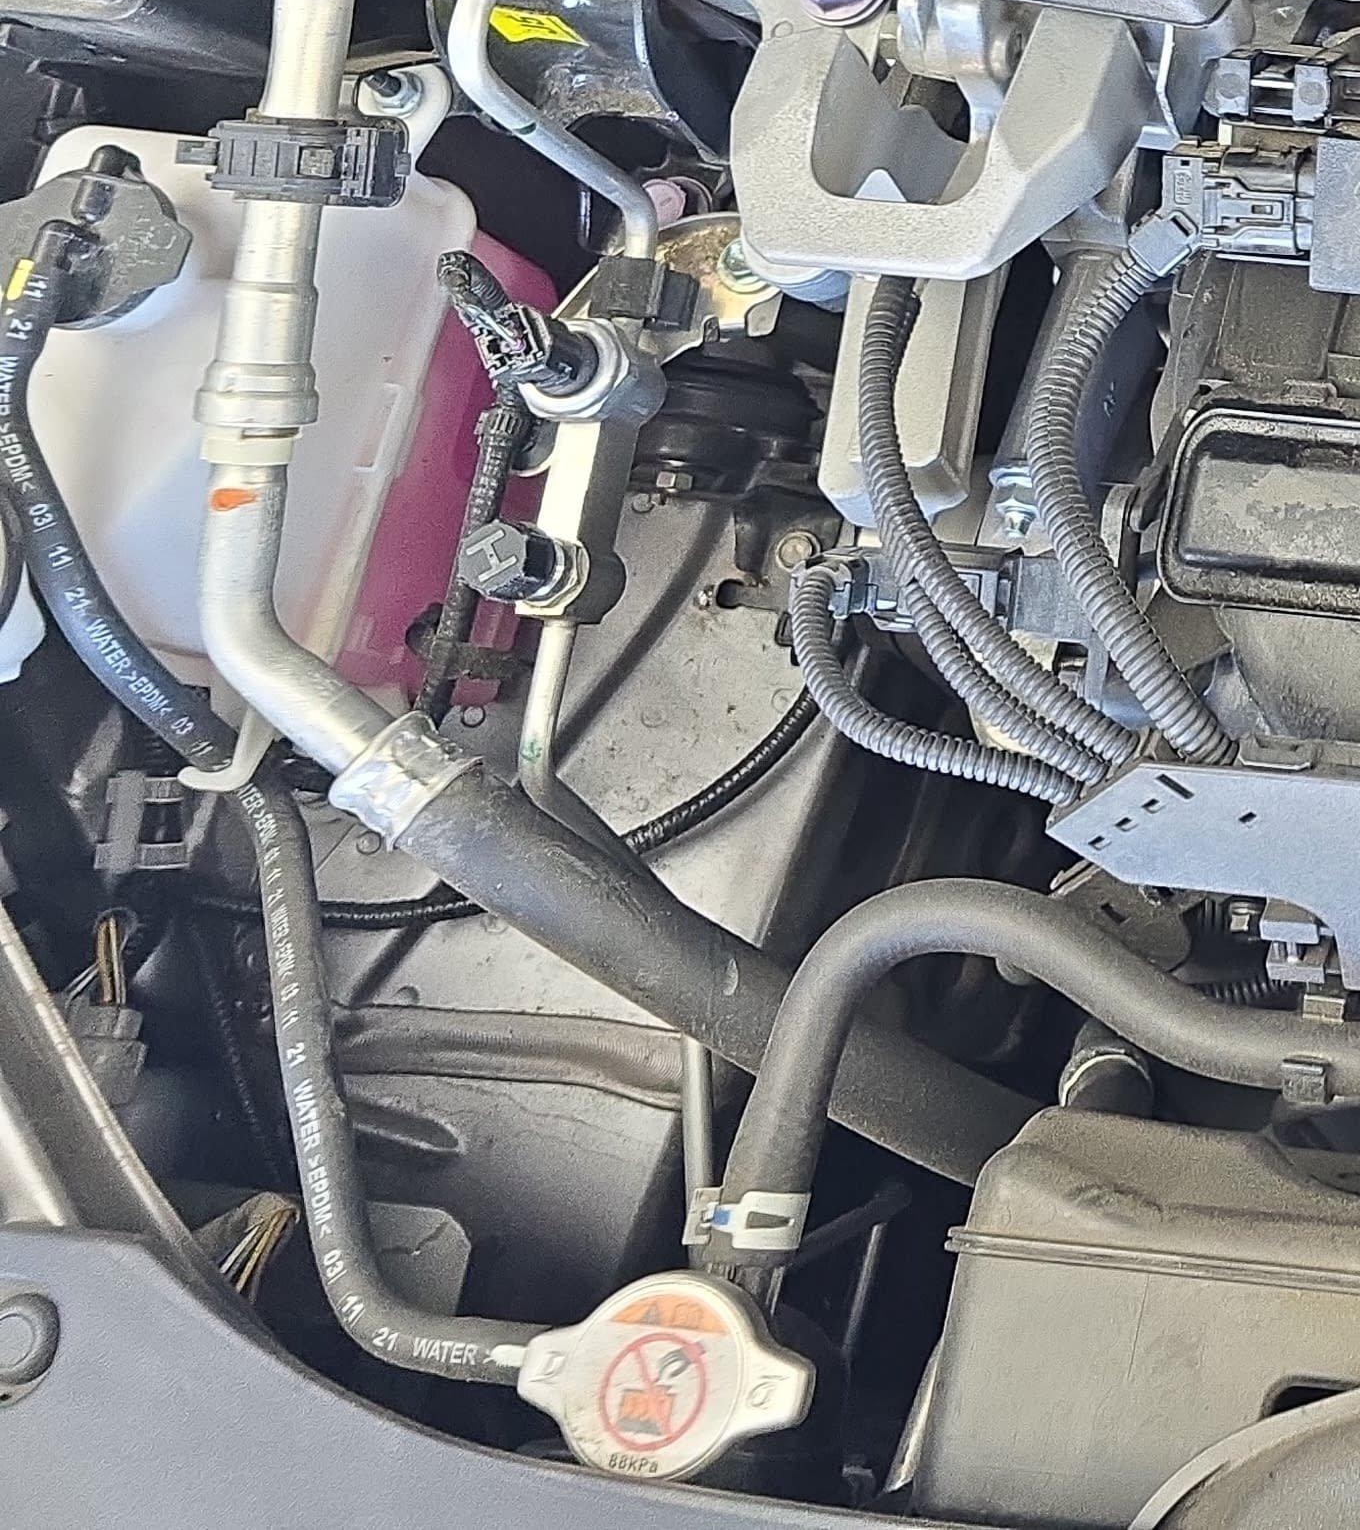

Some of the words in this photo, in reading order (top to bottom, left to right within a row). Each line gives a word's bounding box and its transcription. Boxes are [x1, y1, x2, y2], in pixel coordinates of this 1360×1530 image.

[84, 618, 132, 674] WATER
[286, 1042, 307, 1069] 21
[293, 1077, 321, 1153] WATER
[412, 1336, 479, 1366] WATER
